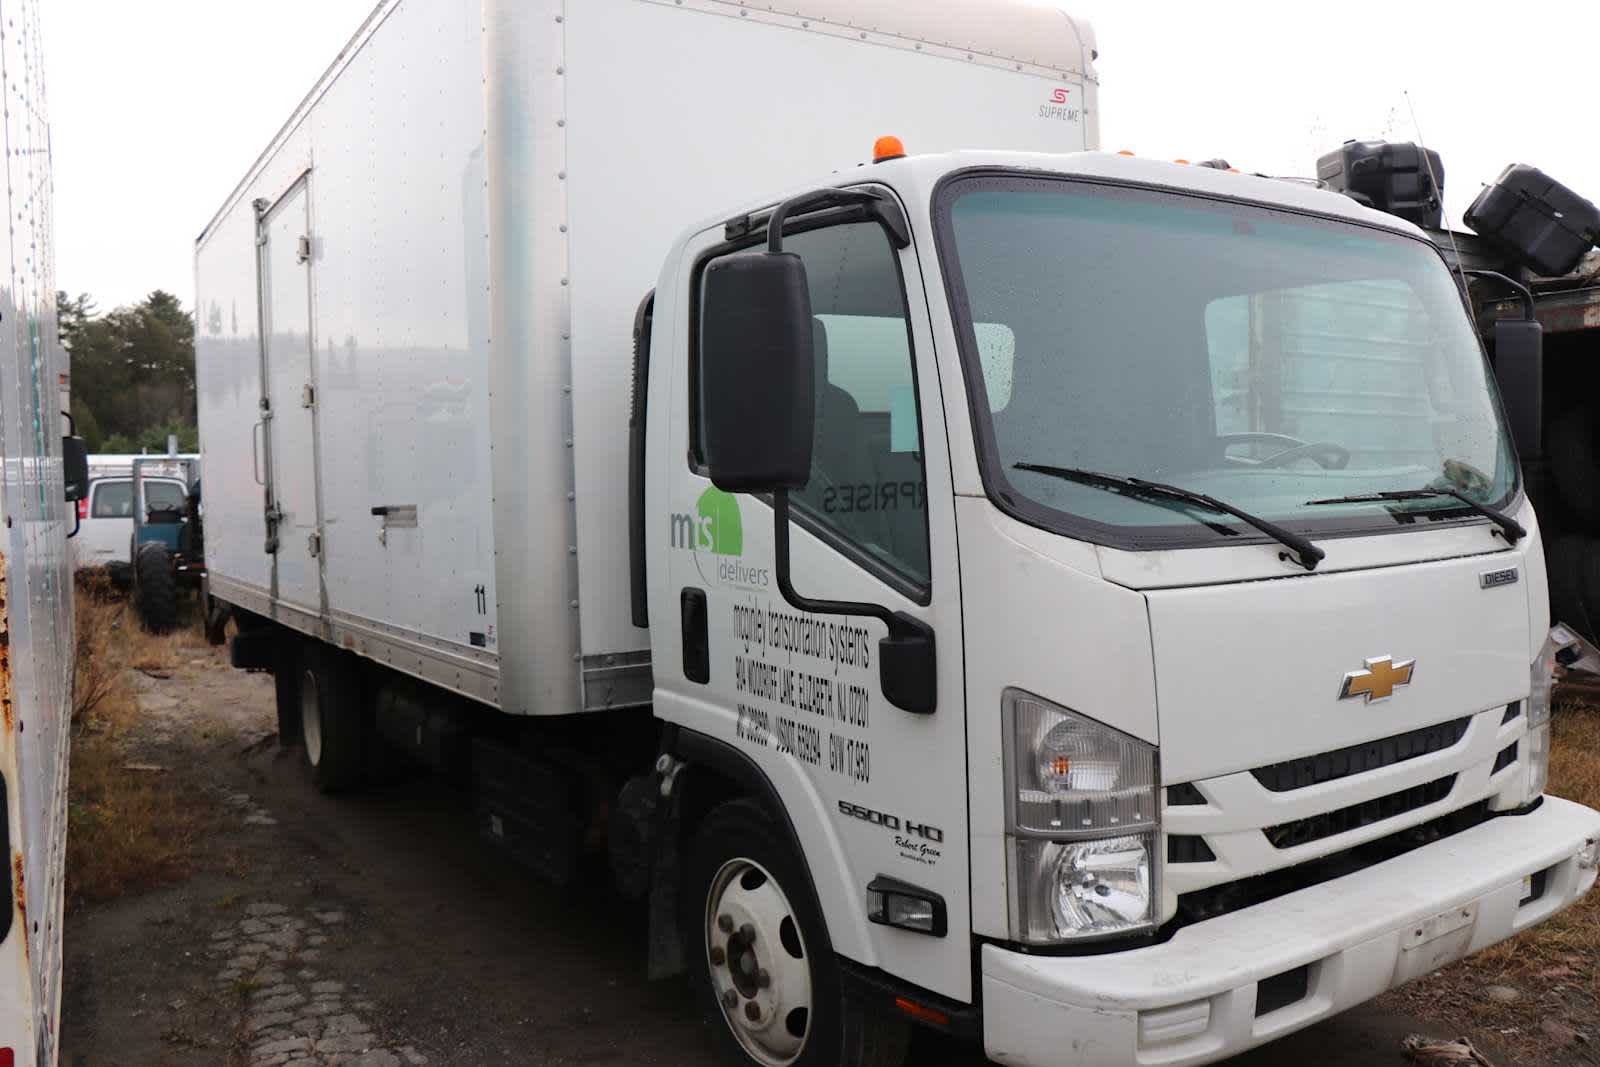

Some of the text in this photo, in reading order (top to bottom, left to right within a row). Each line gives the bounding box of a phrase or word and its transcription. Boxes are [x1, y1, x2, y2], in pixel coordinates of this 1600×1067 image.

[1039, 105, 1079, 122] SUPREME
[670, 506, 714, 552] mts
[719, 557, 769, 586] delivers
[1485, 569, 1517, 585] DIESEL
[474, 584, 486, 616] 11
[733, 595, 870, 676] mcginley transportation systems
[837, 682, 846, 723] NJ
[849, 685, 870, 728] 07201
[829, 732, 844, 774] GVW
[847, 738, 870, 783] 17,950
[838, 800, 944, 843] 5500 HD
[894, 836, 941, 857] Robert Green
